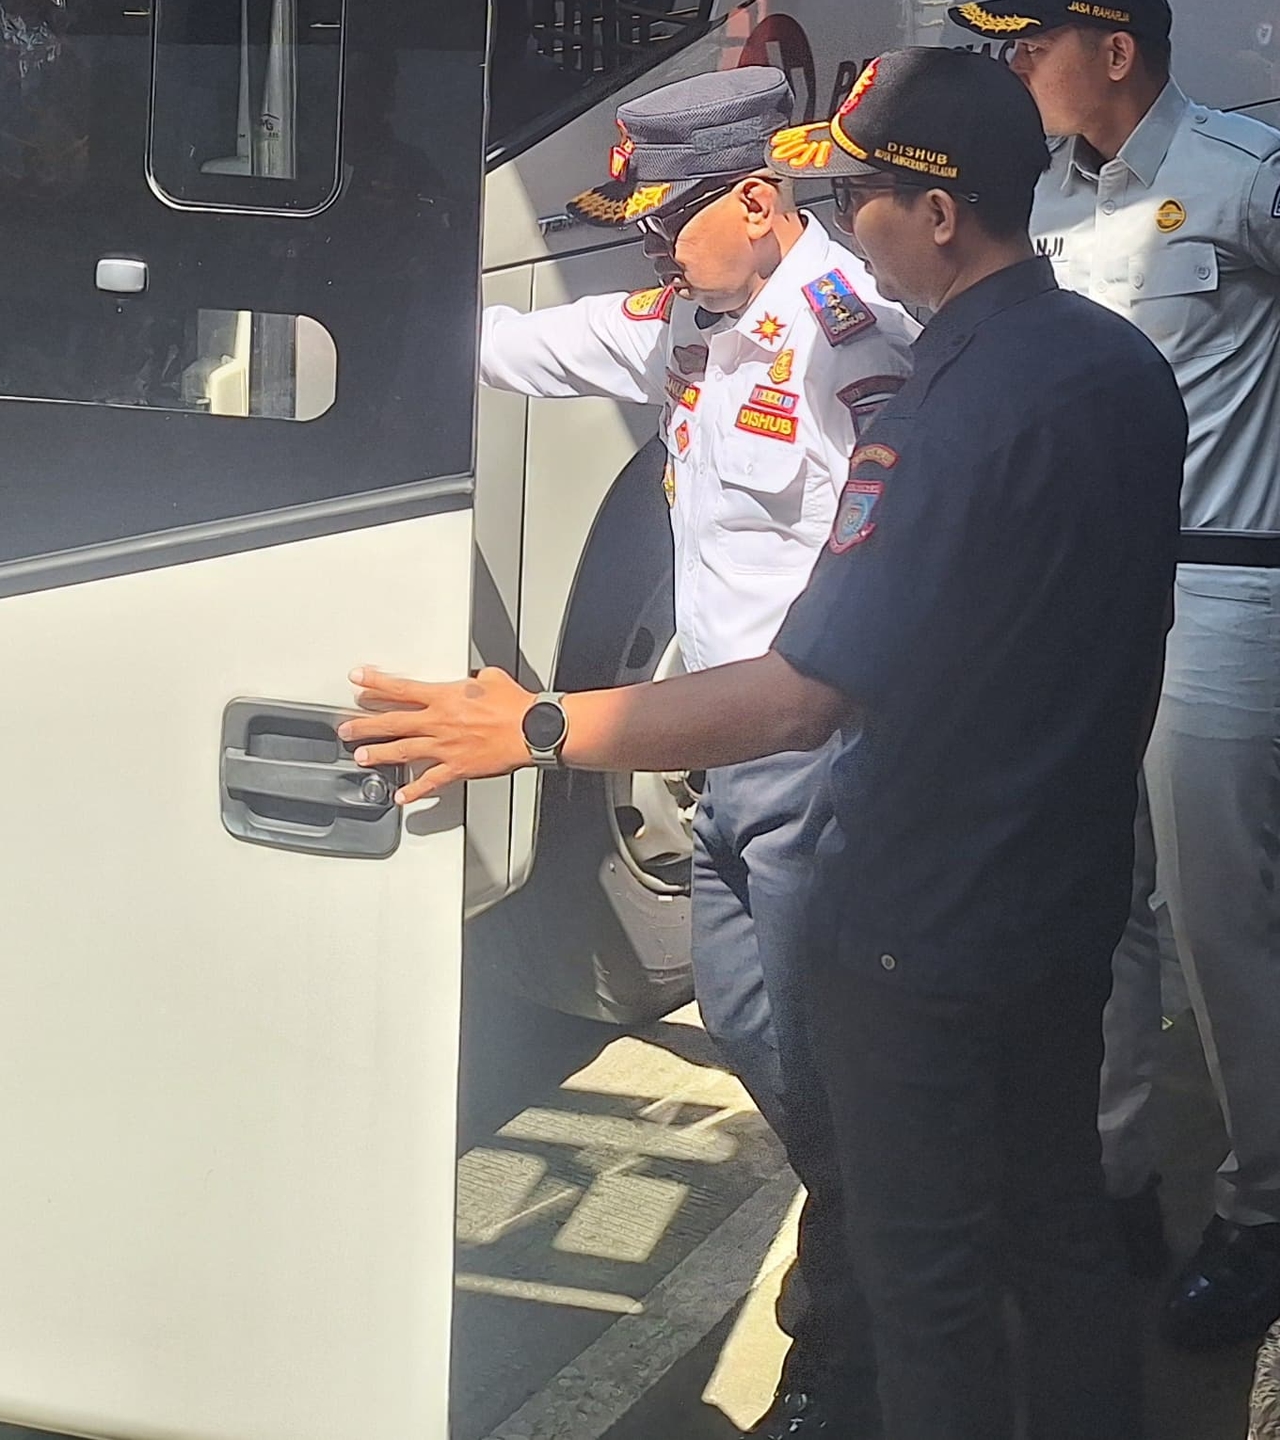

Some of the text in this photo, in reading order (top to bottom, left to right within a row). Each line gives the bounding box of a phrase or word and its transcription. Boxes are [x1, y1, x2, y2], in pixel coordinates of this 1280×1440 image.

[1067, 0, 1091, 15] JASA
[887, 141, 948, 165] DISHUB
[1036, 236, 1065, 258] NJI
[740, 408, 793, 436] DISHUB
